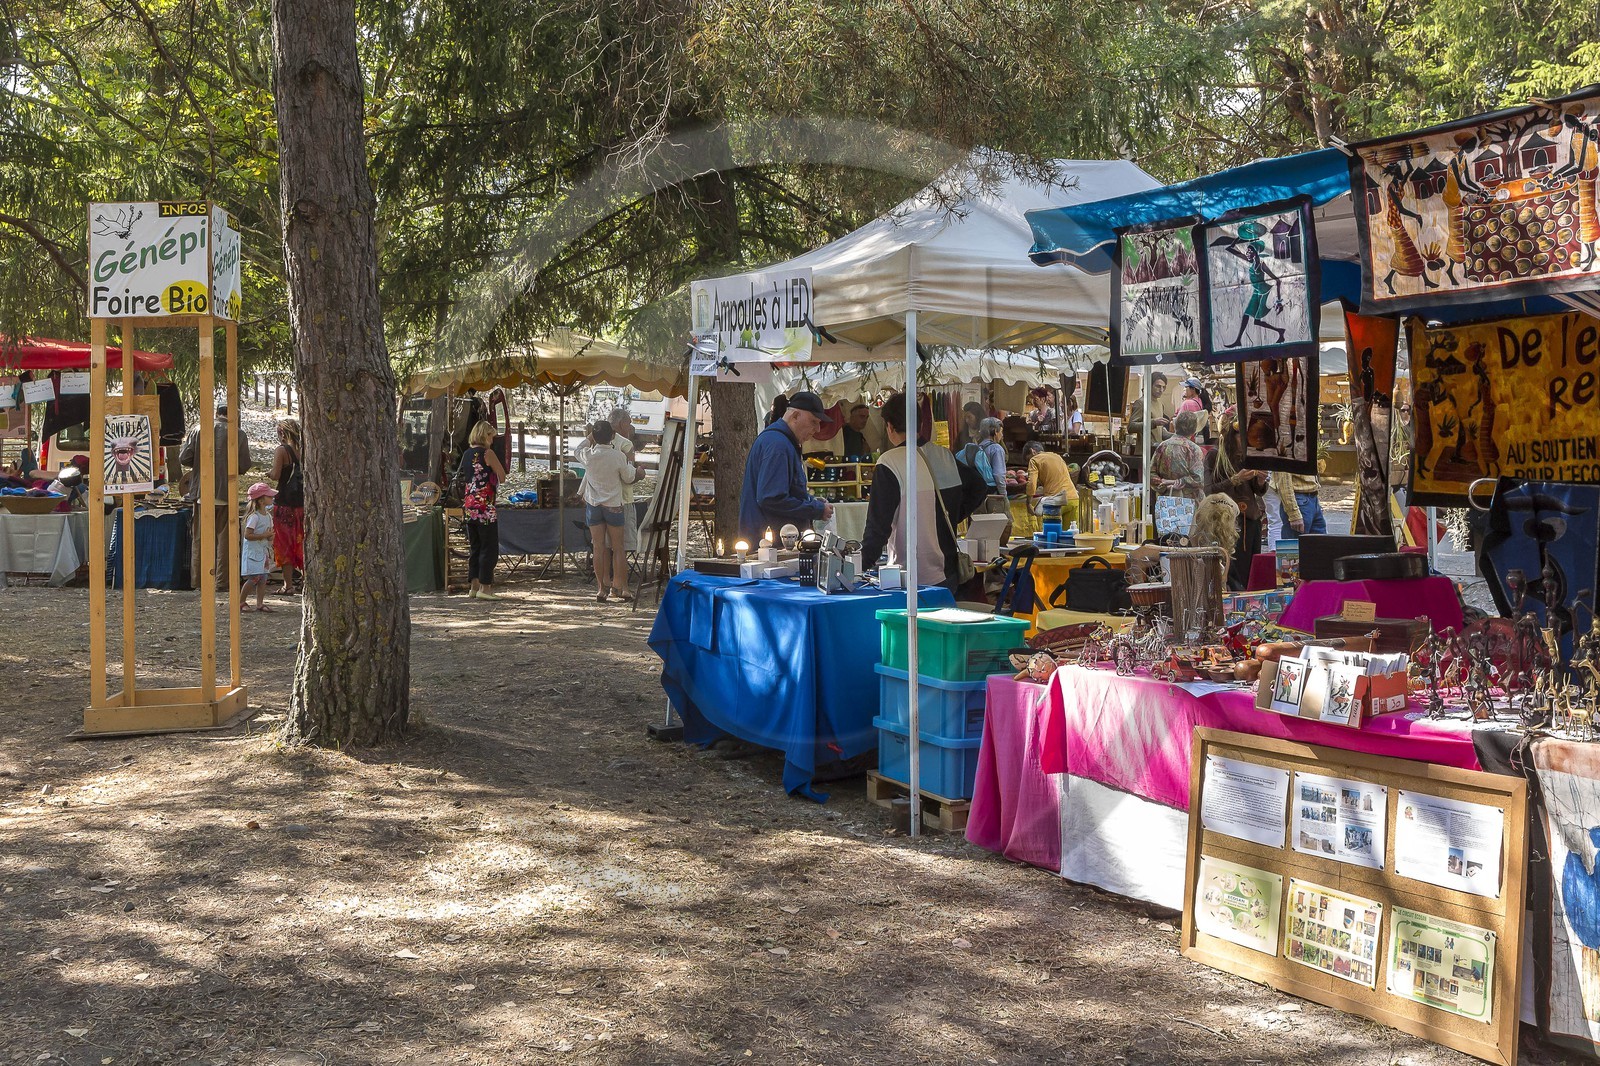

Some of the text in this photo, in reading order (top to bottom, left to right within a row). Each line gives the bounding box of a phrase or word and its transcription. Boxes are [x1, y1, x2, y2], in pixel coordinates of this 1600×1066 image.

[162, 203, 207, 215] INFOS
[93, 219, 206, 282] Génépi
[93, 286, 208, 314] Foire Bio
[712, 277, 810, 345] Ampoules à LED
[1496, 313, 1600, 369] De l'e
[1549, 371, 1600, 421] Re
[1506, 436, 1597, 465] AU SOUTIEN
